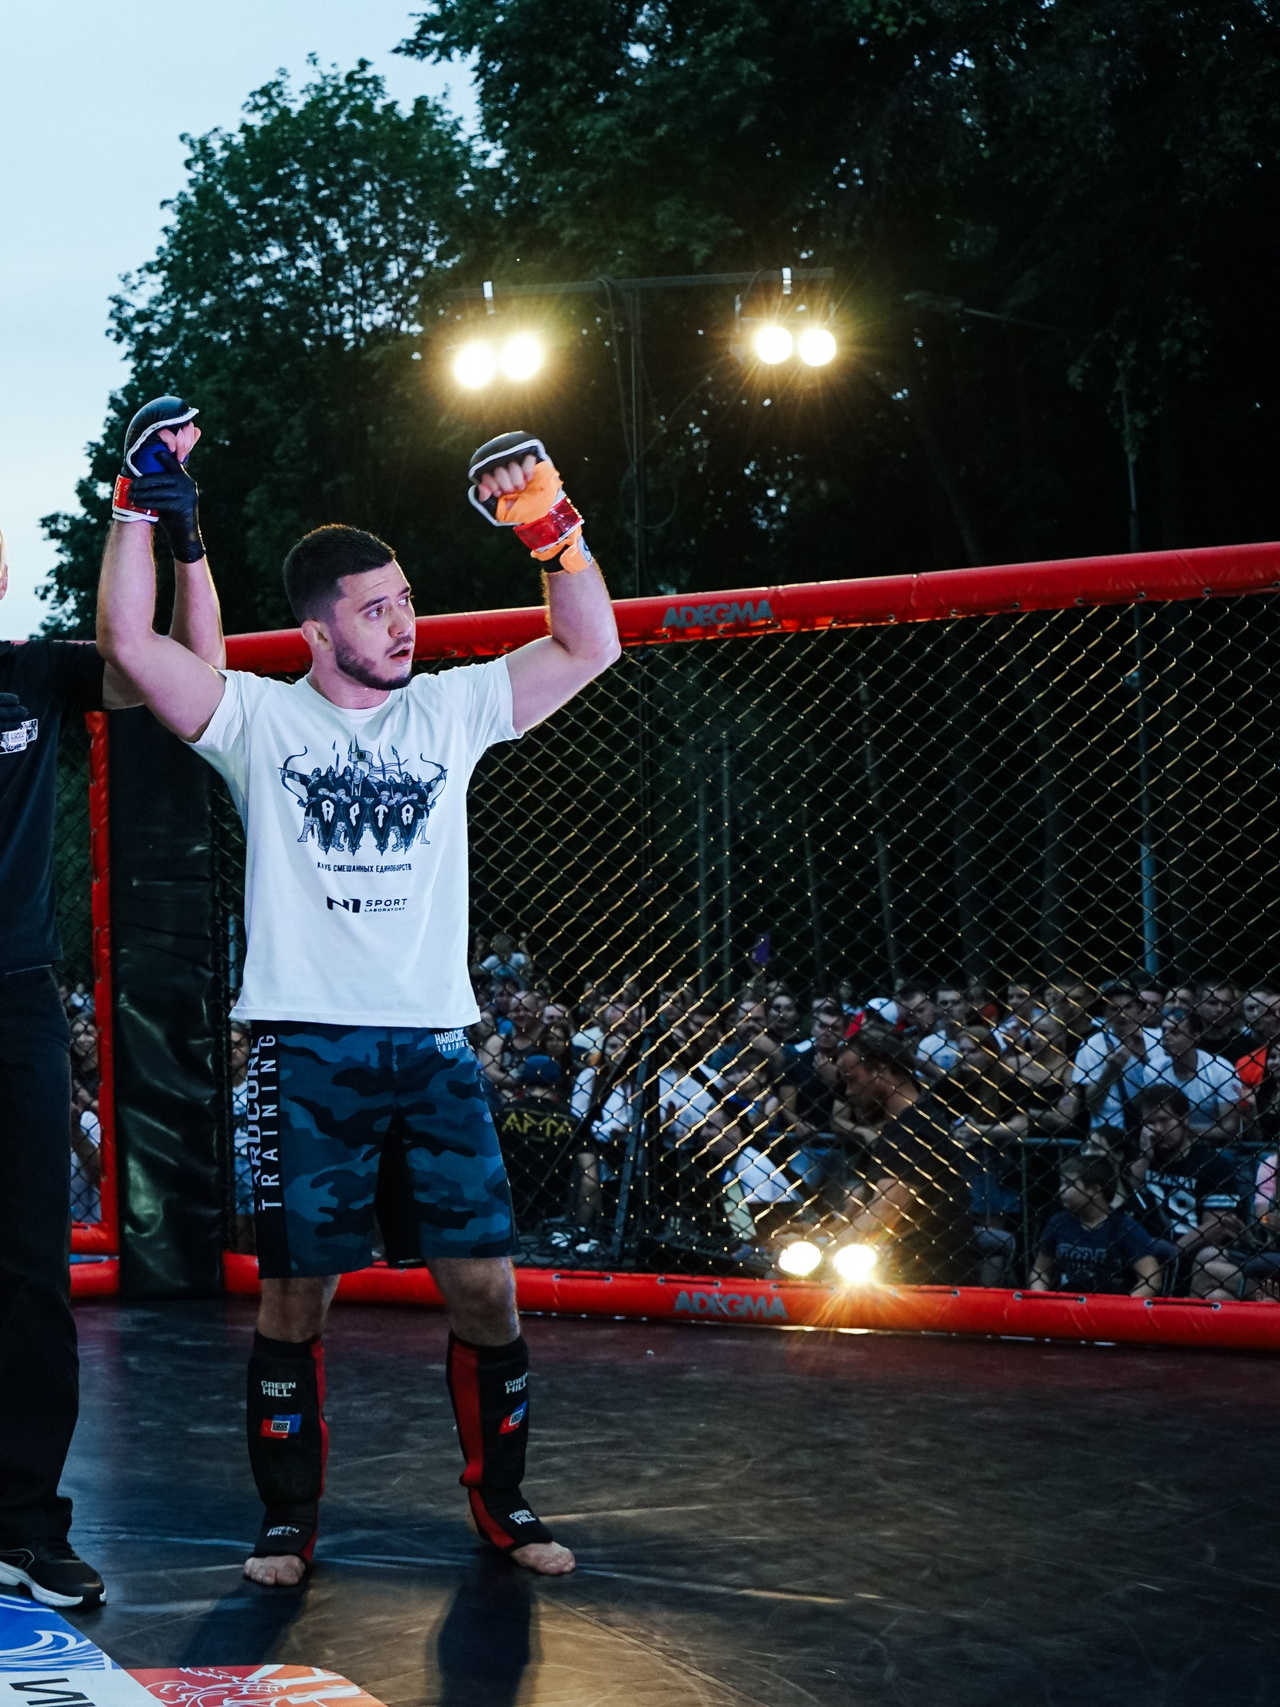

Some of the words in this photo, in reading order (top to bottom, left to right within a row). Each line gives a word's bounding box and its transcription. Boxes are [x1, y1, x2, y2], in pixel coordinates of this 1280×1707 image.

[662, 600, 774, 629] ADEGMA
[333, 864, 374, 873] СМЕШАННЫХ
[376, 863, 412, 873] ЕДИНОБОРСТВ
[365, 898, 408, 907] SPORT
[246, 1038, 261, 1194] RDCORE
[260, 1034, 282, 1211] TRAINING
[261, 1380, 296, 1390] GREEN
[506, 1380, 527, 1394] HILL
[262, 1387, 291, 1397] HILL
